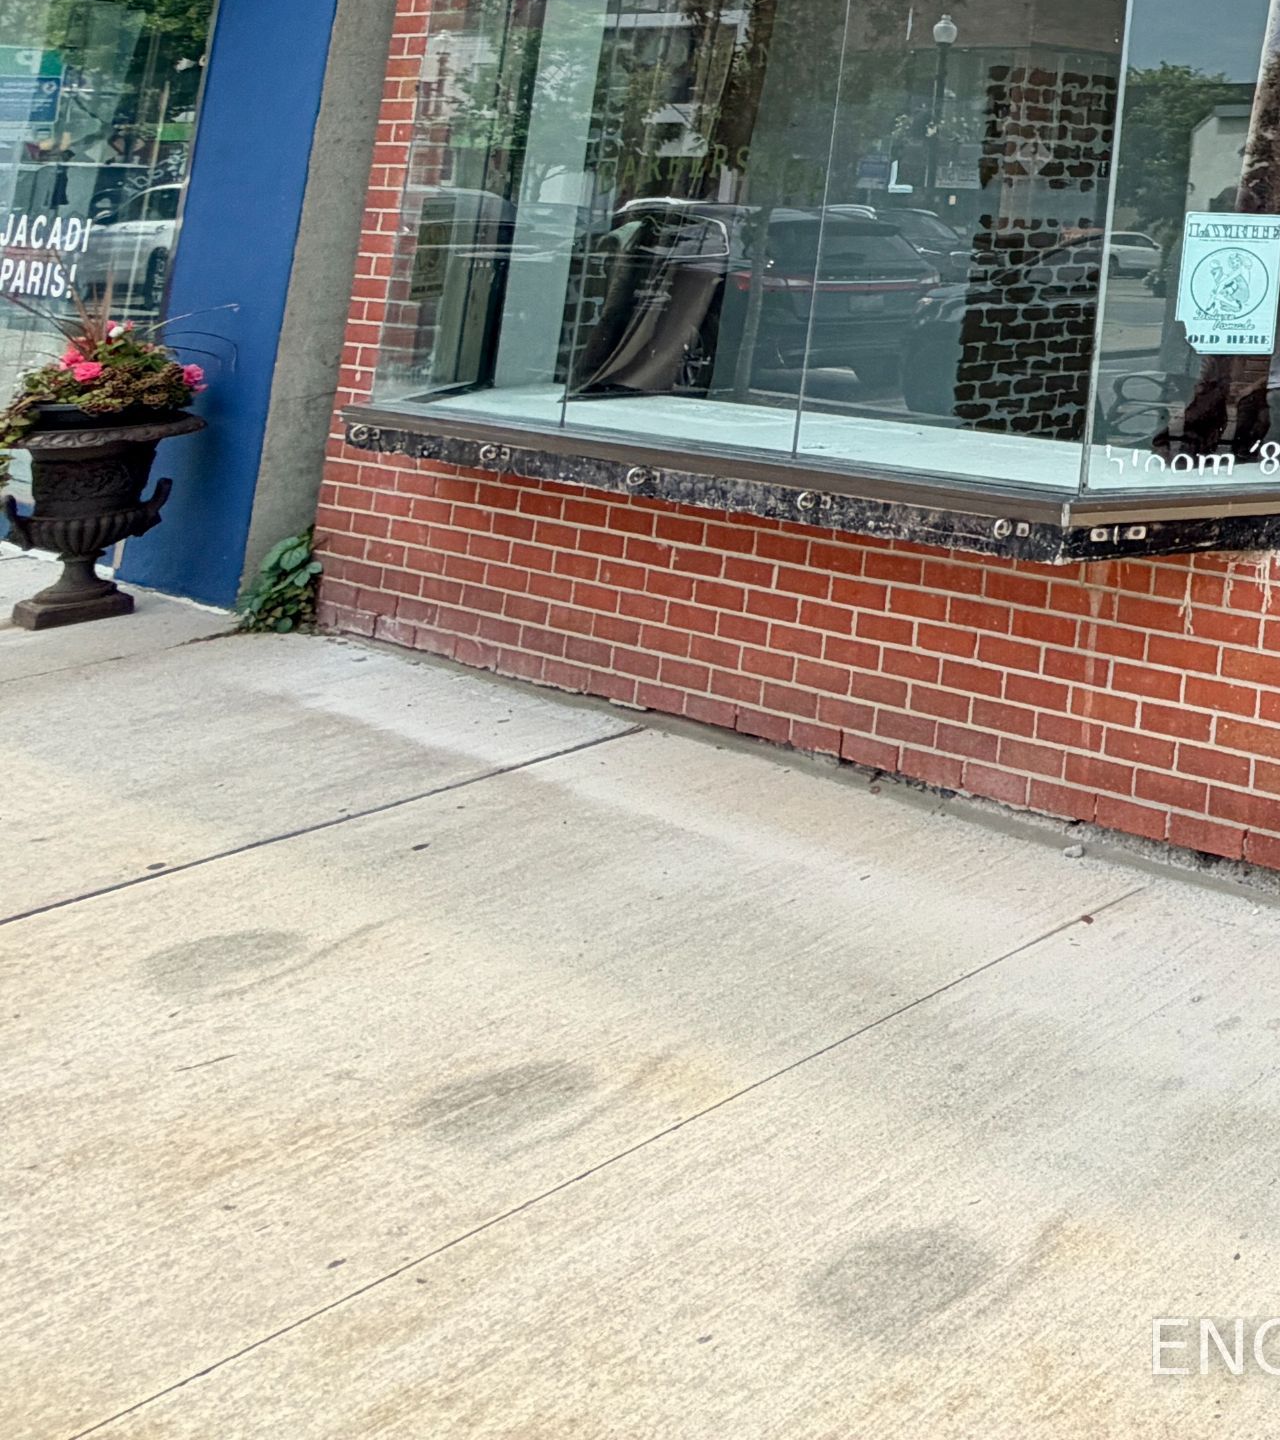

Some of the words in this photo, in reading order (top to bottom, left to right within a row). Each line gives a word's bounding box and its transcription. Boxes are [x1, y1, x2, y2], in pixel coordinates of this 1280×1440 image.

[0, 213, 93, 253] JACADI
[1189, 223, 1280, 241] LAYRITE
[0, 258, 77, 299] PARIS!
[1187, 334, 1220, 345] OLD
[1226, 334, 1271, 345] HERE
